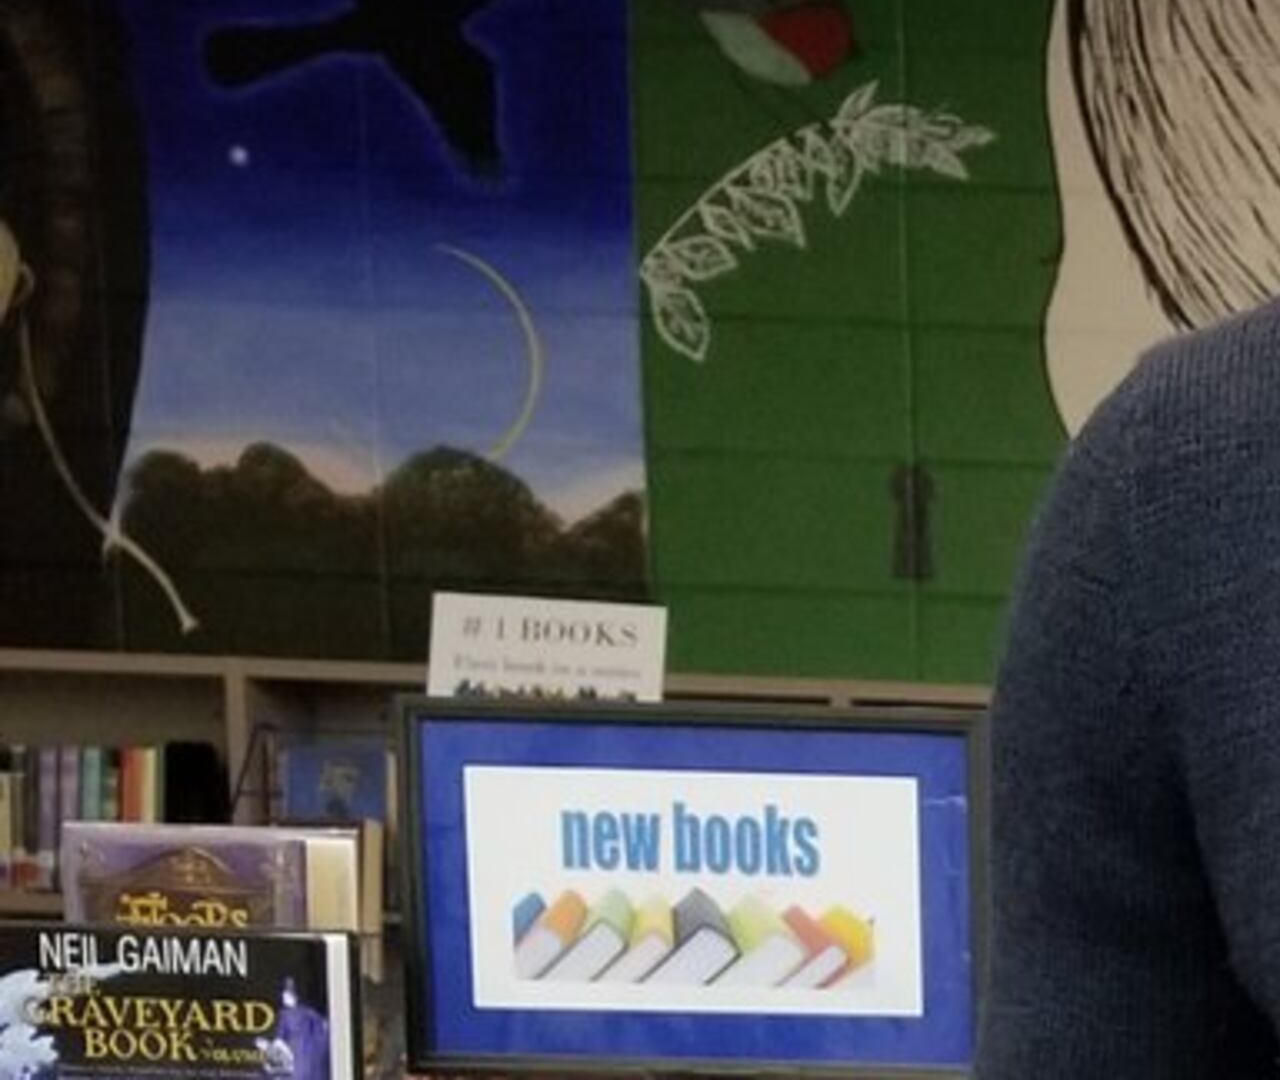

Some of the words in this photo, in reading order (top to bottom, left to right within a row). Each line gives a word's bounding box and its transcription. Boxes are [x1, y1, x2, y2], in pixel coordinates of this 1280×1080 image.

[462, 616, 482, 637] #
[497, 616, 505, 640] 1
[521, 617, 638, 648] BOOKS
[562, 809, 659, 871] new
[673, 802, 819, 876] books
[39, 932, 98, 970] NEIL
[117, 934, 248, 977] GAIMAN
[23, 995, 275, 1034] GRAVEYARD
[84, 1028, 198, 1061] BOOK
